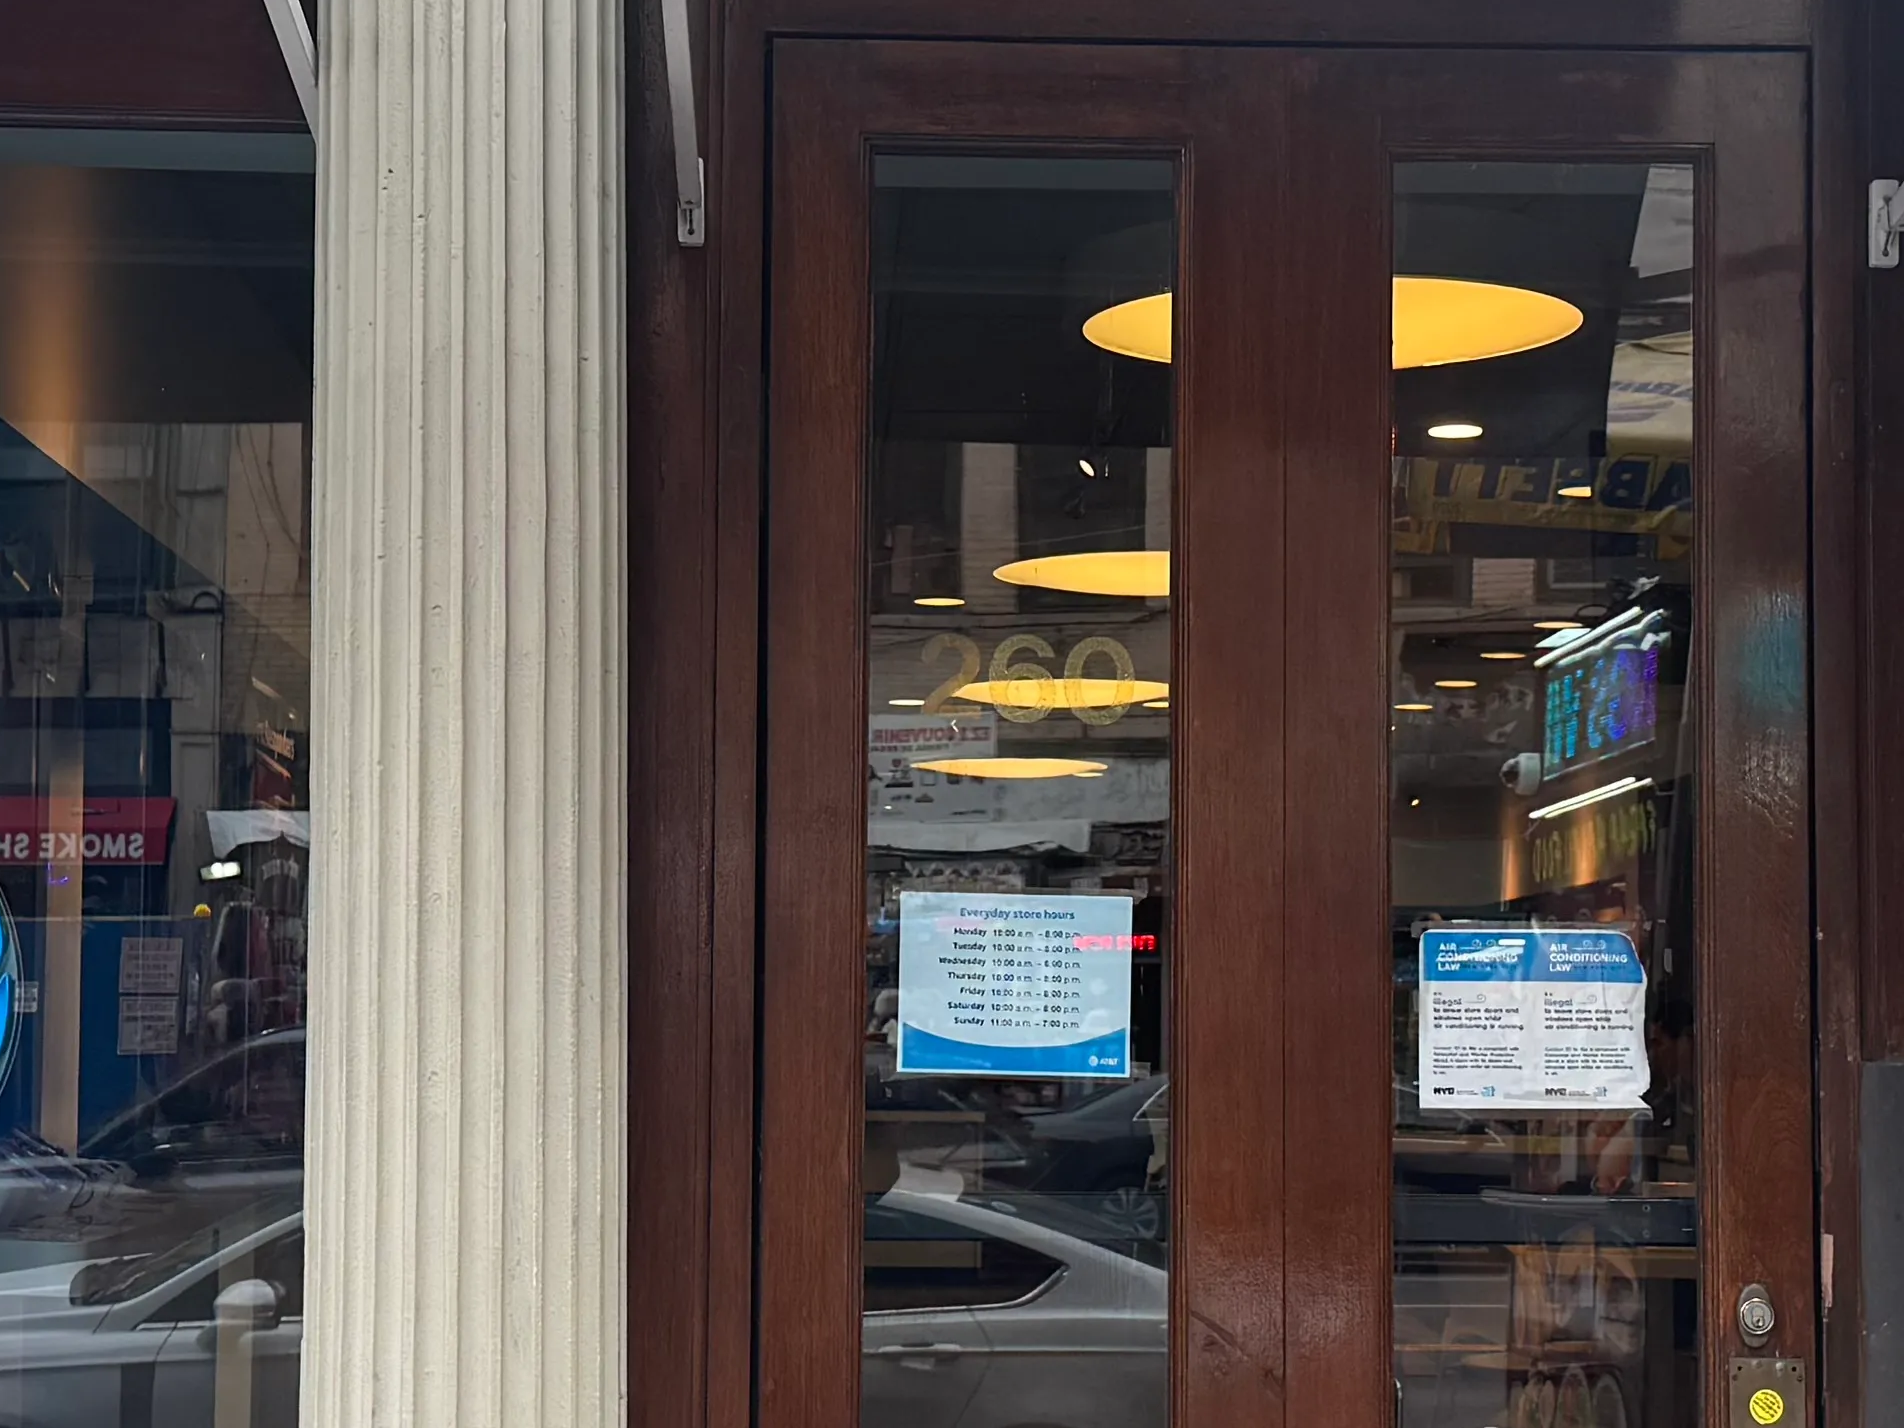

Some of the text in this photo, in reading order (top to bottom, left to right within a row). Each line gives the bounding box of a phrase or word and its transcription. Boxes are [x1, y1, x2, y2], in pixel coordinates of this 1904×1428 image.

[921, 632, 1136, 726] 260
[960, 907, 1075, 920] Everyday store hours
[954, 928, 987, 937] Monday
[953, 942, 986, 952] Tuesday
[1439, 943, 1457, 951] AIR
[1549, 943, 1567, 952] AIR
[939, 957, 986, 967] Wednesday
[1549, 953, 1628, 963] CONDITIONING
[1438, 963, 1461, 971] LAW
[1549, 963, 1572, 972] LAW
[948, 971, 986, 981] Thursday
[960, 987, 986, 996] Friday
[948, 1001, 985, 1011] Saturday
[954, 1017, 985, 1026] Sunday
